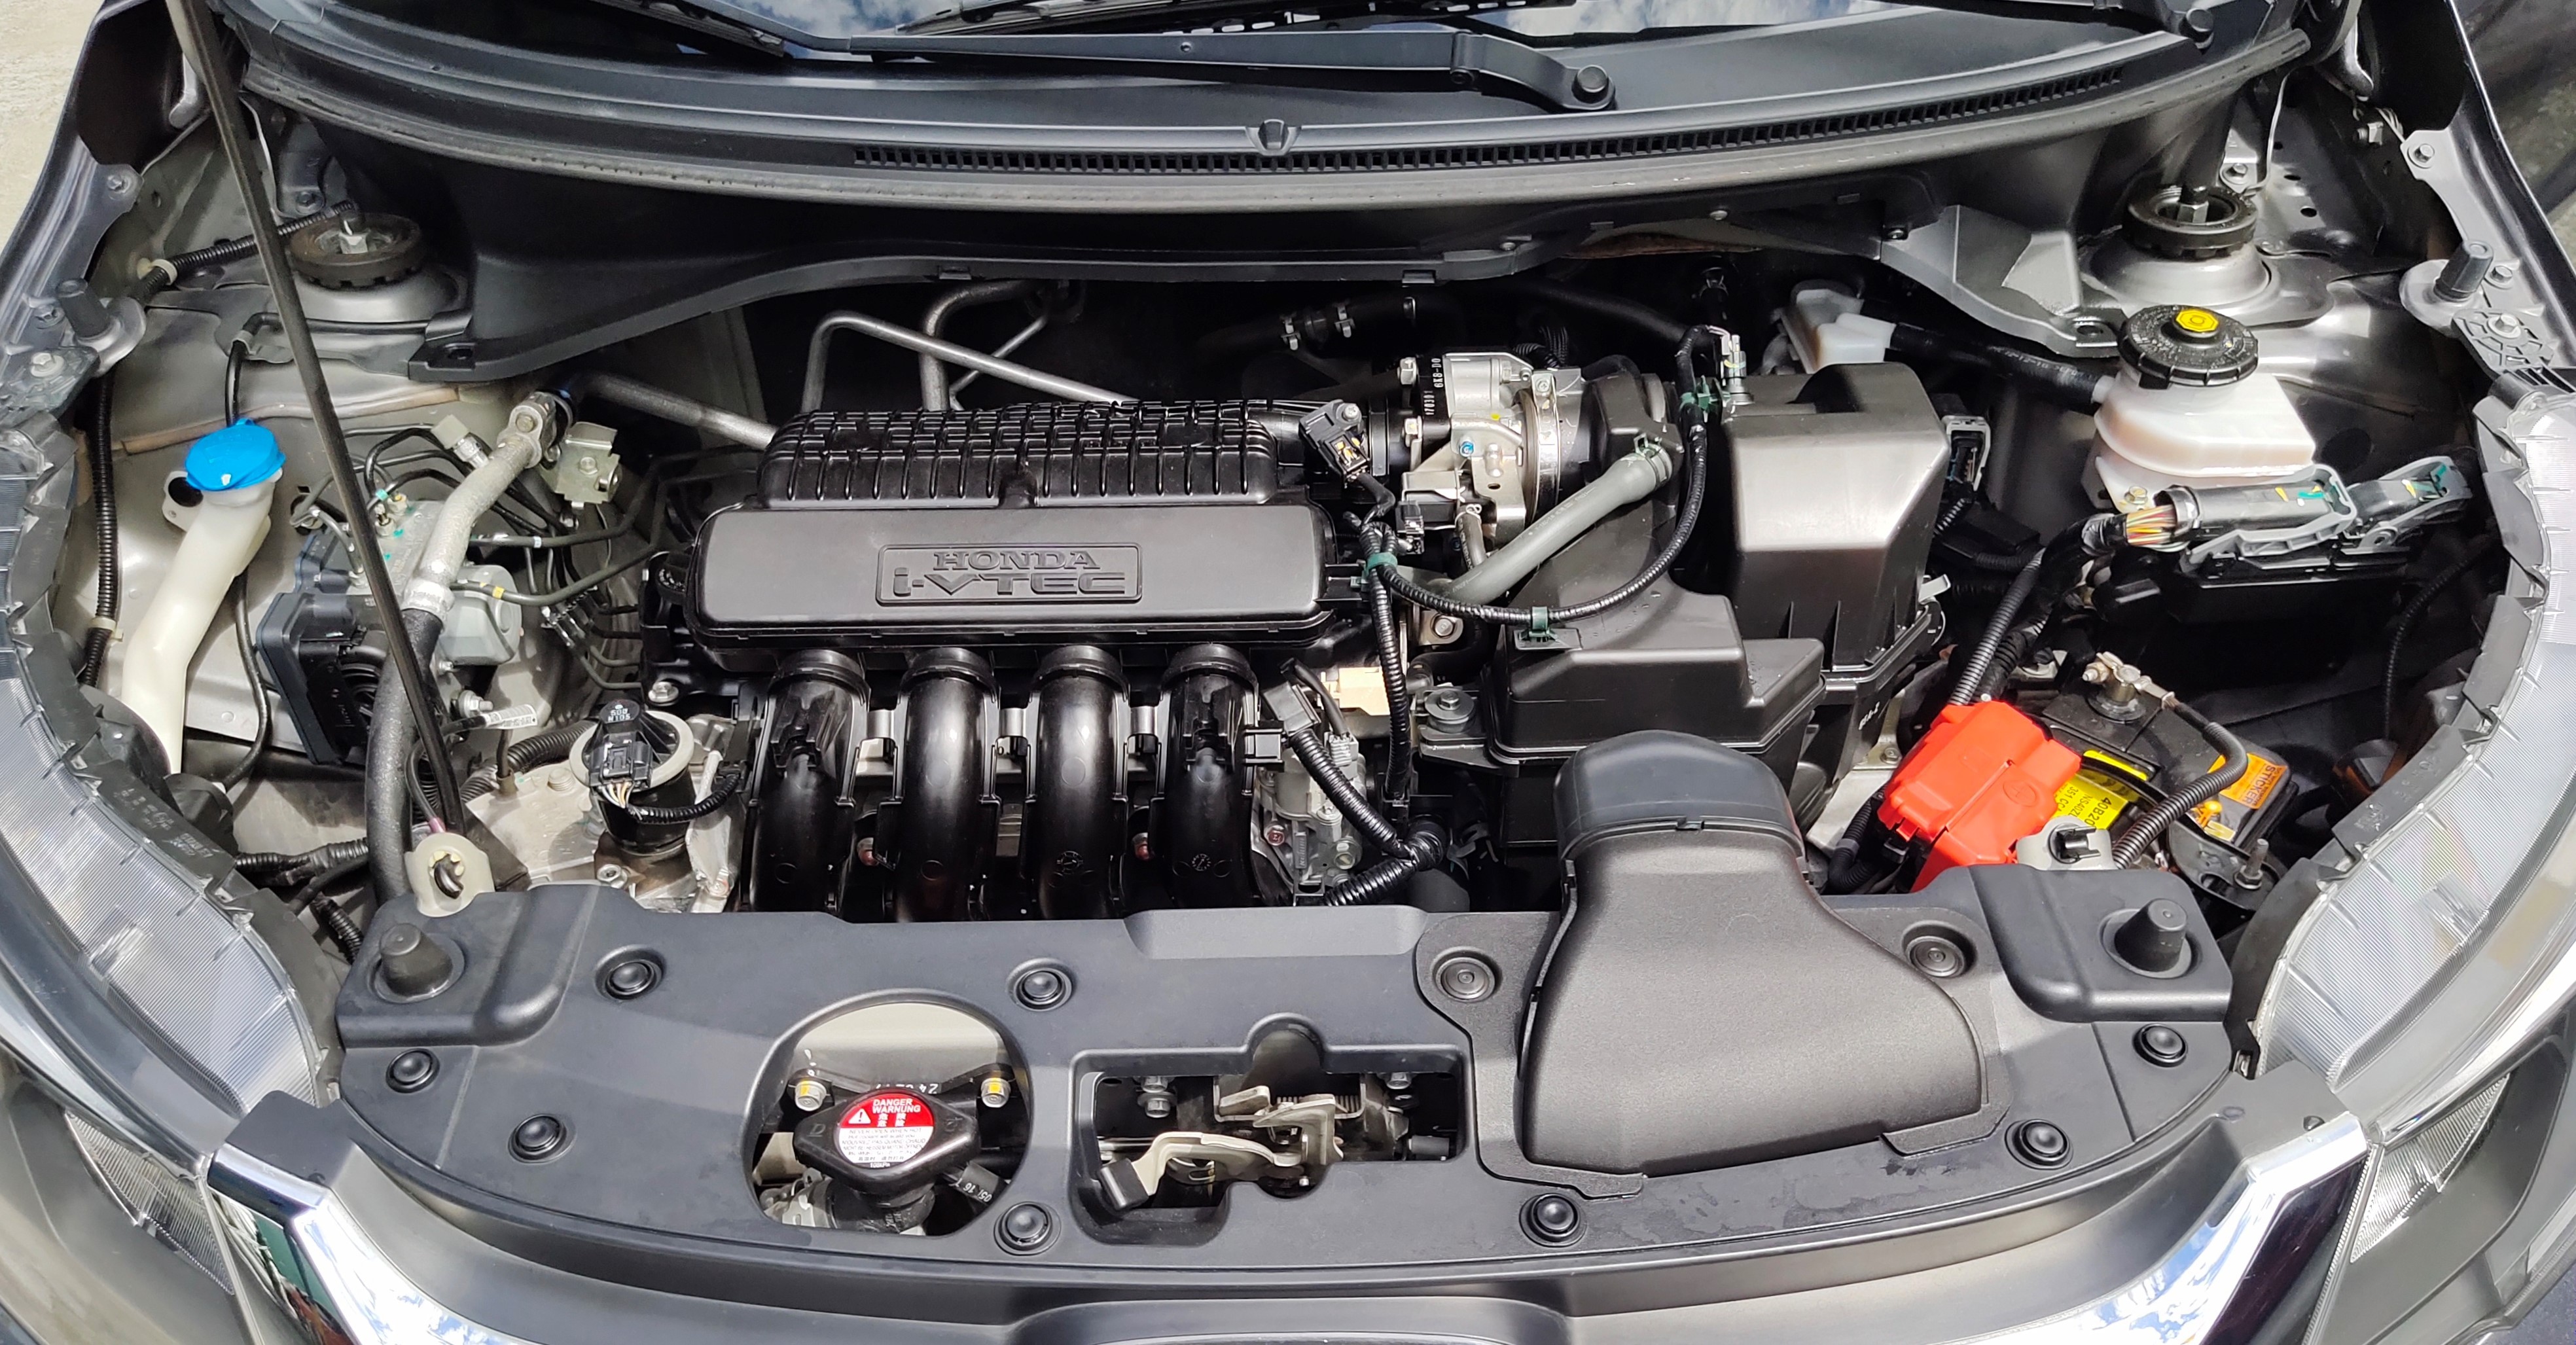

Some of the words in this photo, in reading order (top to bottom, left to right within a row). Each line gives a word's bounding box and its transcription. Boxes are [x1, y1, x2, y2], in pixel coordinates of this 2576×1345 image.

[933, 550, 1100, 571] HONDA
[893, 567, 1126, 597] i-VTEC
[2242, 764, 2277, 804] STICKER
[872, 1105, 921, 1114] WARNUNG
